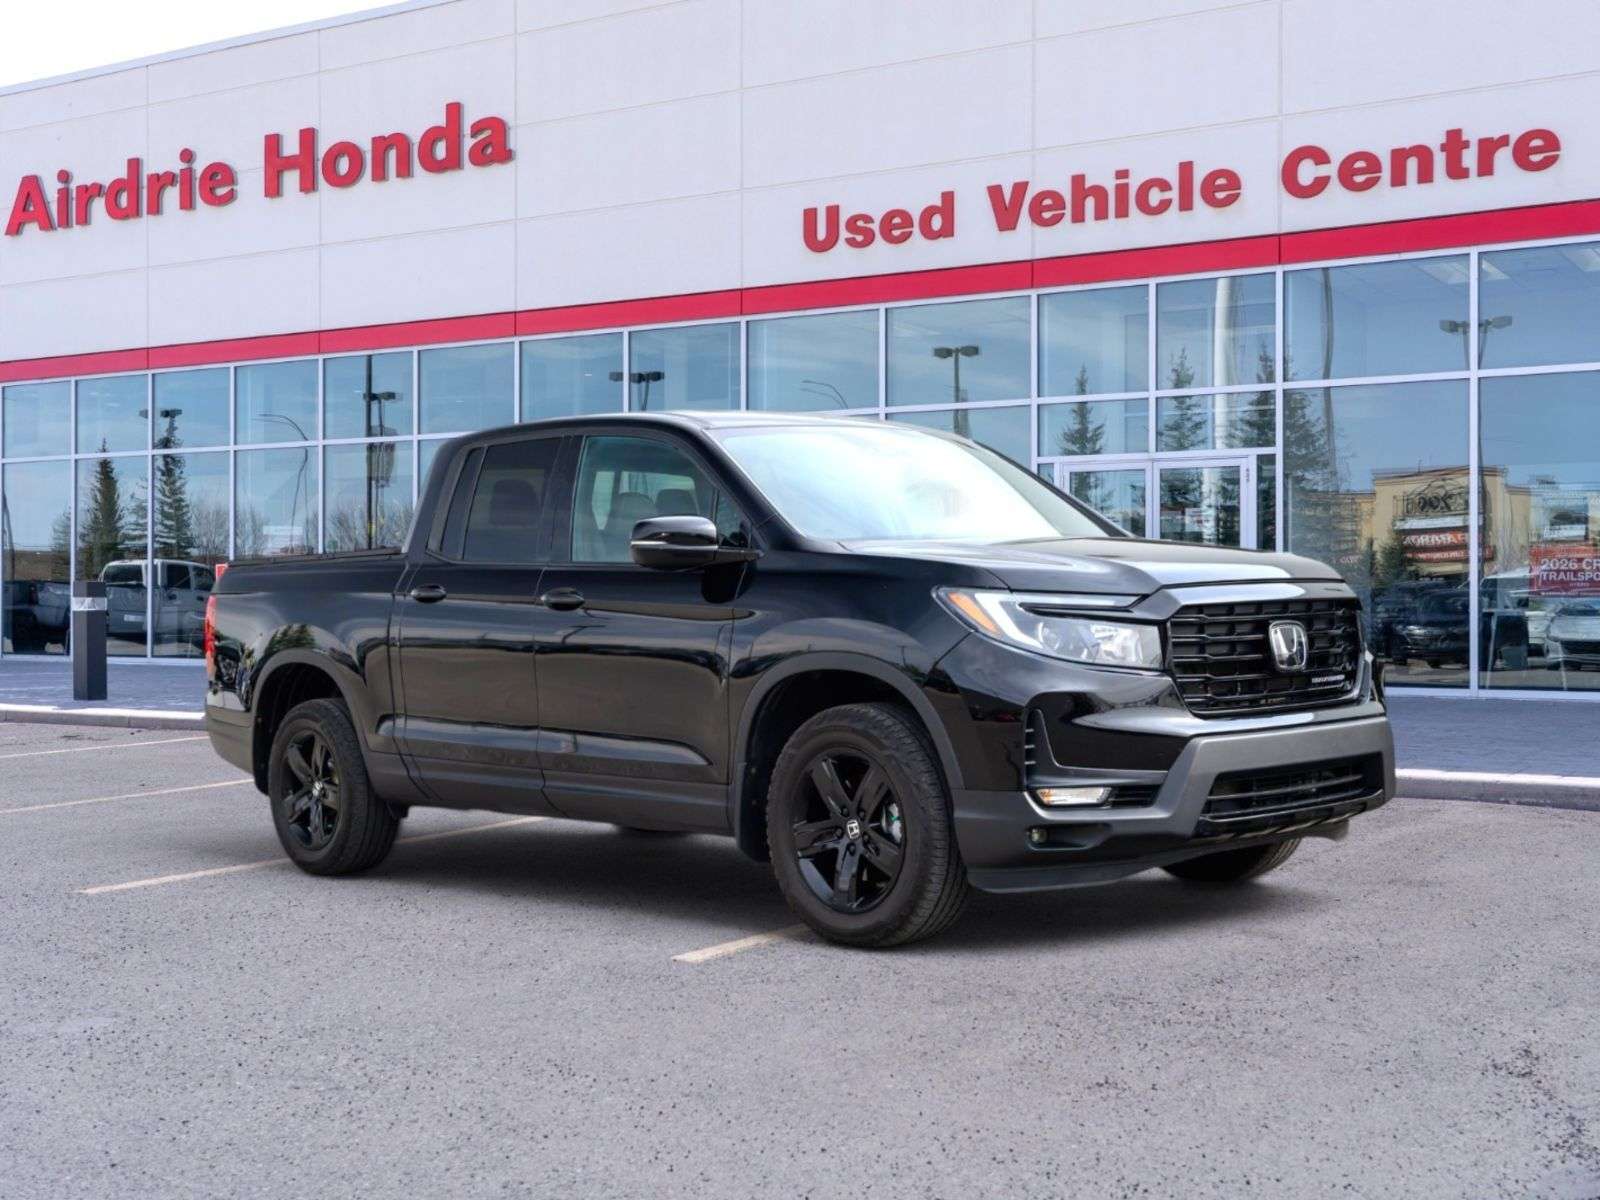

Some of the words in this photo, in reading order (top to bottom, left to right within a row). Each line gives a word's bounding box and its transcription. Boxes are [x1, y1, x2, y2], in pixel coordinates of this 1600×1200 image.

[5, 149, 236, 236] Airdrie
[264, 102, 513, 198] Honda
[803, 191, 955, 252] Used
[987, 161, 1241, 231] Vehicle
[1283, 128, 1561, 198] Centre
[1540, 558, 1578, 570] 2026
